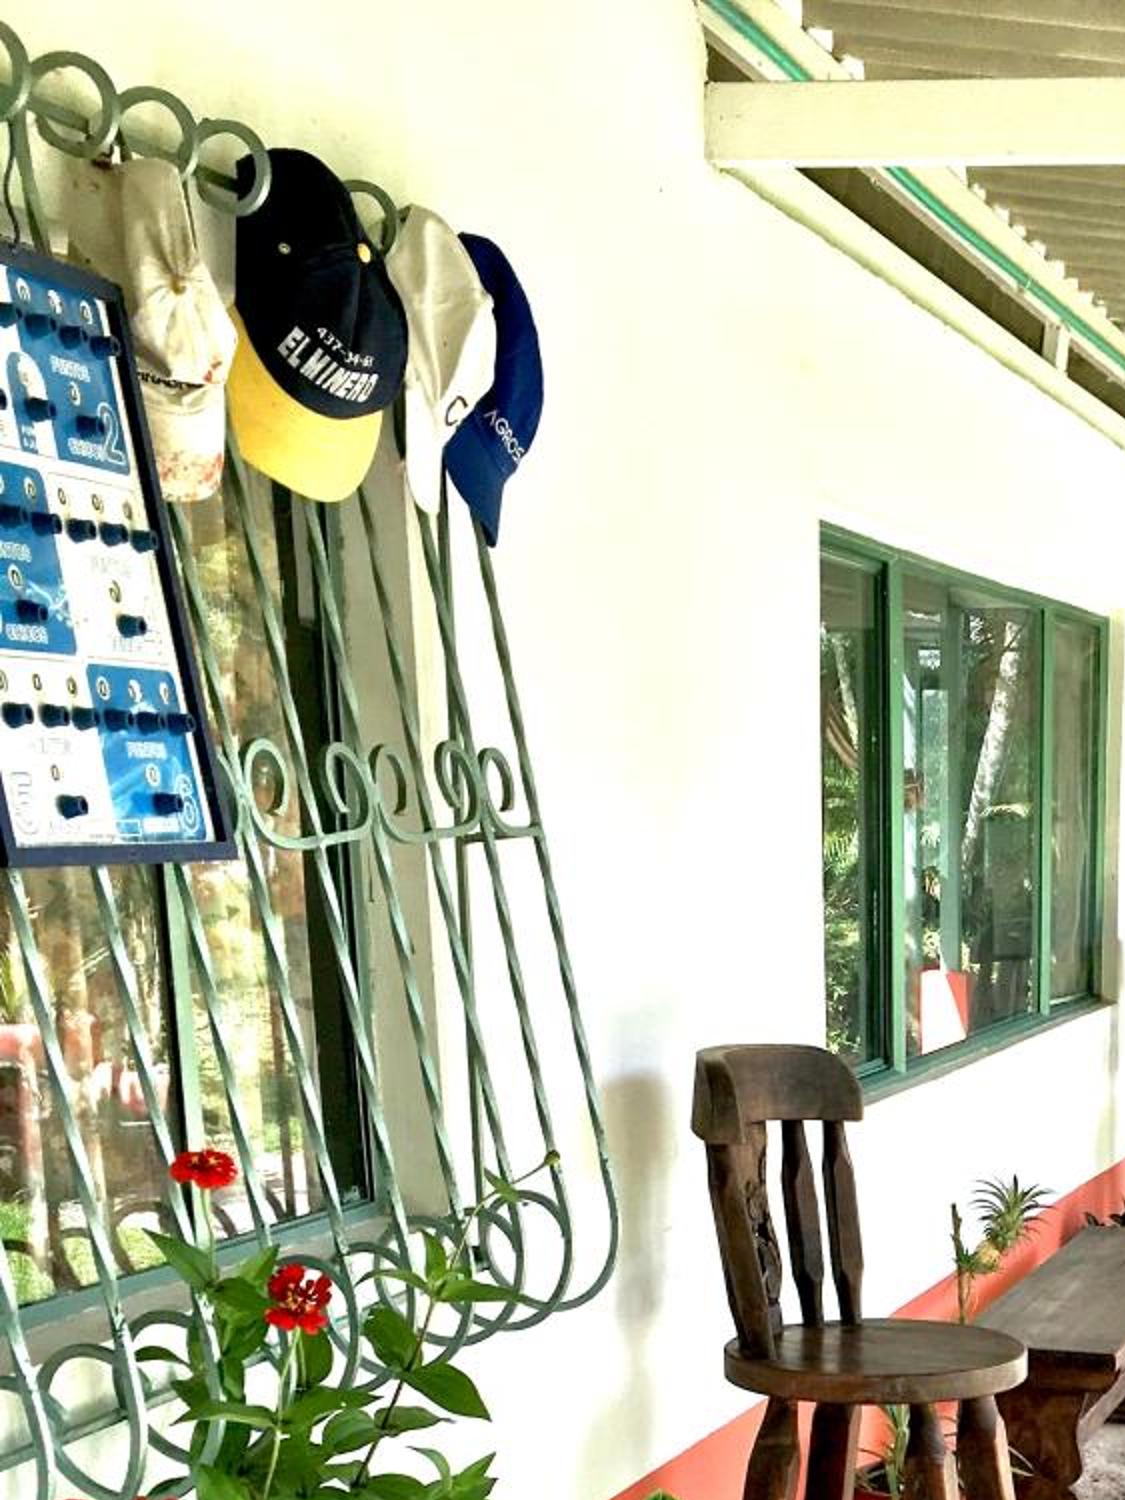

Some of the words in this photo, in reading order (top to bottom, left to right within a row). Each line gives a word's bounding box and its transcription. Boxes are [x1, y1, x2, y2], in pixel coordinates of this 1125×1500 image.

[277, 325, 311, 369] EL
[300, 347, 379, 403] MINERO
[97, 402, 126, 466] 2
[483, 408, 525, 465] AGROS
